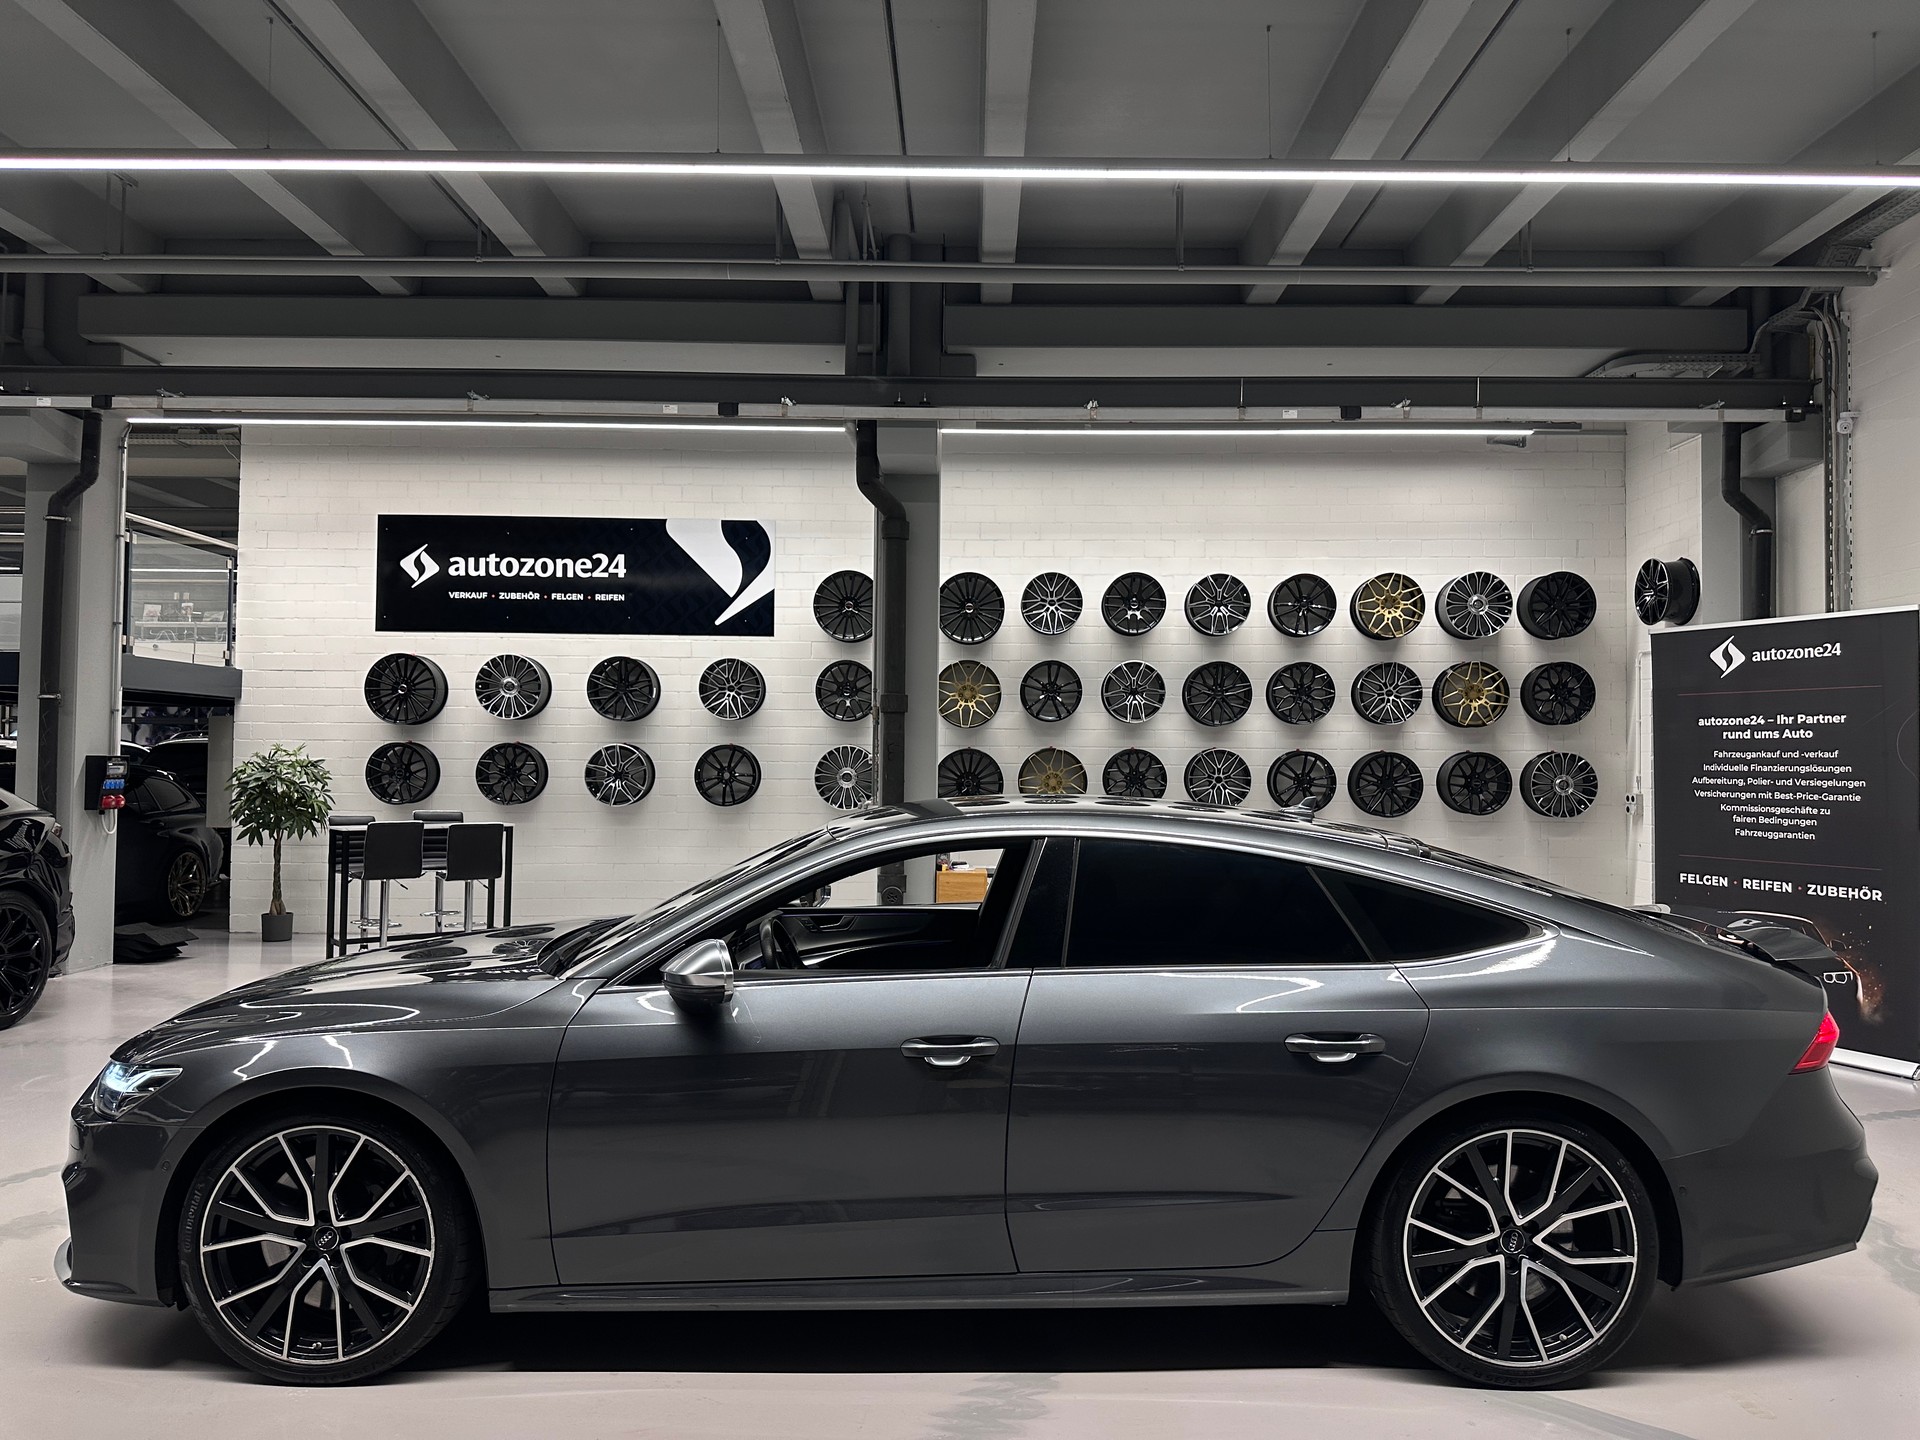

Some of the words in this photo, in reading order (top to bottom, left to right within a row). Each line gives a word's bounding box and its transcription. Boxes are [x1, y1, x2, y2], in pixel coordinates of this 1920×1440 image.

[448, 553, 626, 578] autozone24
[448, 591, 488, 600] VERKAUF
[498, 590, 541, 600] ZUBEHÖR
[551, 592, 584, 601] FELGEN
[594, 593, 625, 602] REIFEN
[1752, 643, 1841, 661] autozone24
[1697, 715, 1766, 727] autozone24
[1776, 713, 1795, 725] Ihr
[1797, 713, 1847, 725] Partner
[1722, 728, 1751, 740] rund
[1753, 730, 1780, 740] ums
[1781, 728, 1814, 739] Auto
[1713, 749, 1781, 760] Fahrzeugankauf
[1781, 749, 1800, 759] und
[1800, 749, 1839, 759] -verkauf
[1703, 763, 1749, 772] Individuelle
[1750, 763, 1853, 775] Finanzierungslösungen
[1691, 776, 1746, 787] Aufbereitung,
[1747, 776, 1774, 786] Polier-
[1775, 777, 1793, 786] und
[1794, 777, 1867, 789] Versiegelungen
[1693, 789, 1757, 801] Versicherungen
[1757, 790, 1773, 800] mit
[1773, 791, 1862, 802] Best-Price-Garantie
[1720, 803, 1819, 816] Kommissionsgeschäfte
[1732, 814, 1757, 824] fairen
[1758, 815, 1818, 828] Bedingungen
[1734, 828, 1816, 840] Fahrzeuggarantien
[1680, 873, 1728, 887] FELGEN
[1743, 879, 1792, 893] REIFEN
[1807, 884, 1882, 901] ZUBEHÖR
